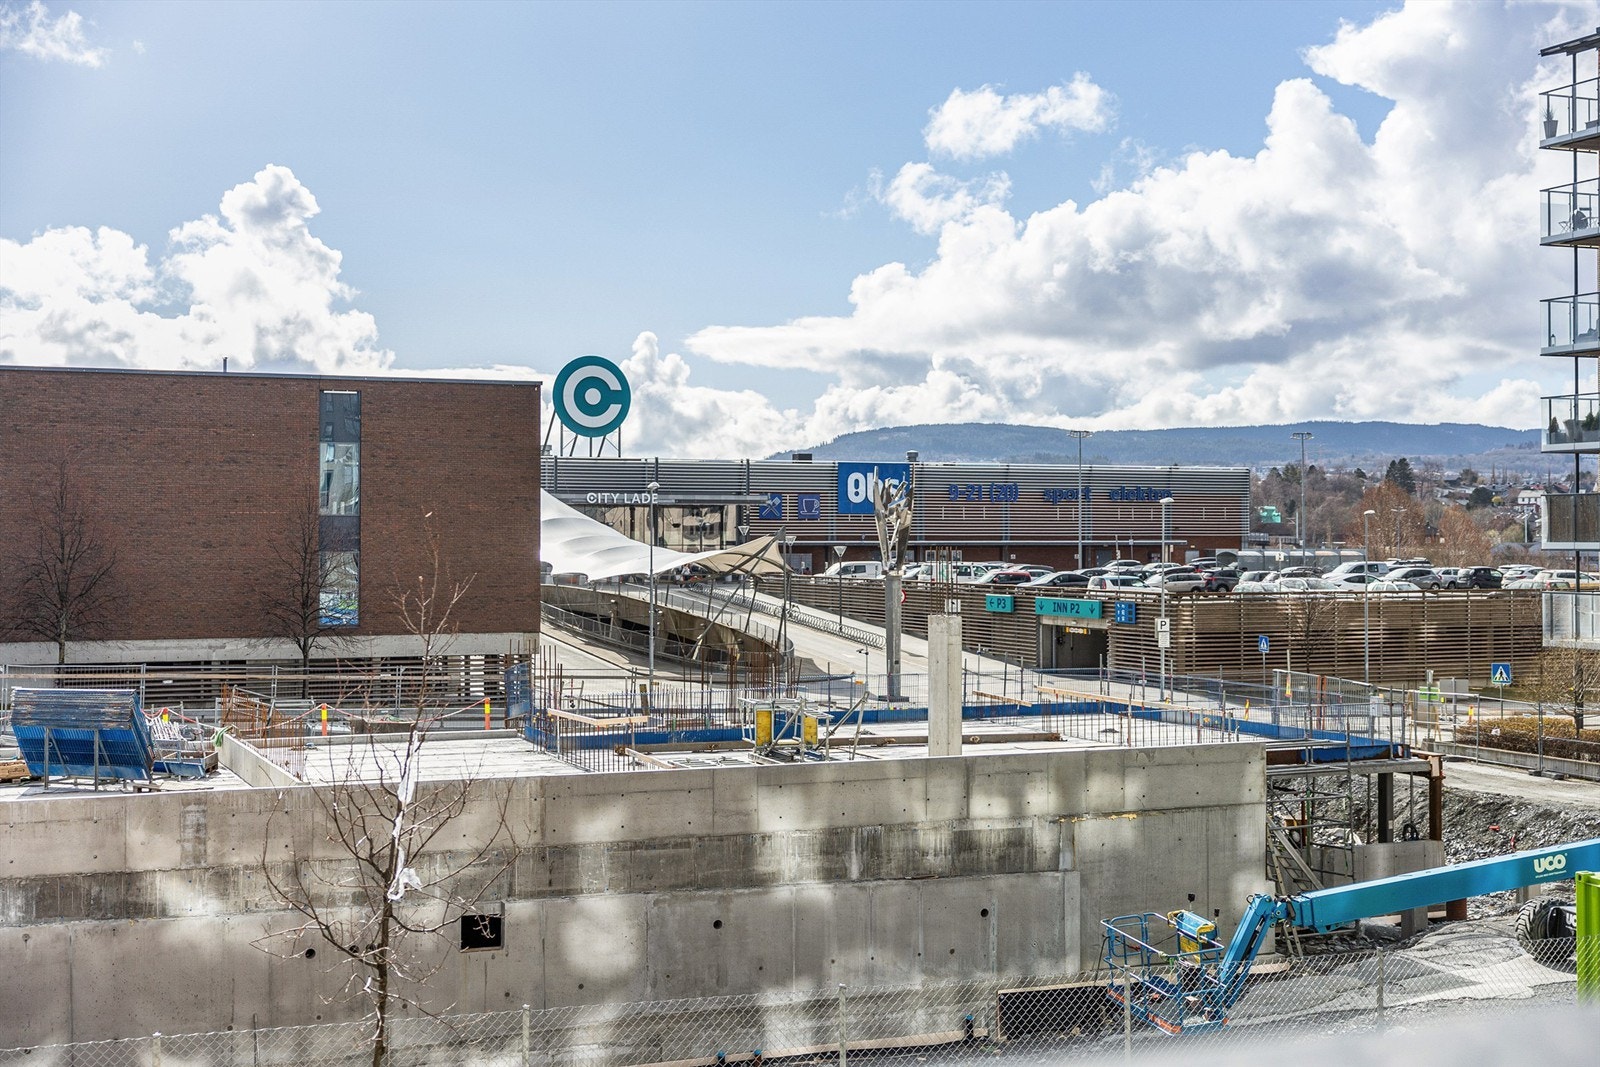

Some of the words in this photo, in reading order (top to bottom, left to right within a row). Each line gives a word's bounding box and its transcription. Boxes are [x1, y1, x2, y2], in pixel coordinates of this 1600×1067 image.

[586, 492, 620, 504] CITY
[624, 493, 659, 504] LADE
[949, 484, 983, 501] 9-21
[989, 482, 1019, 504] (20)
[1044, 485, 1092, 505] sport
[1110, 485, 1172, 501] elektro
[996, 598, 1007, 609] P3
[1052, 602, 1068, 613] INN
[1070, 603, 1080, 614] P2
[1160, 620, 1167, 630] P
[1533, 854, 1567, 873] UCO
[1566, 912, 1577, 927] UC
